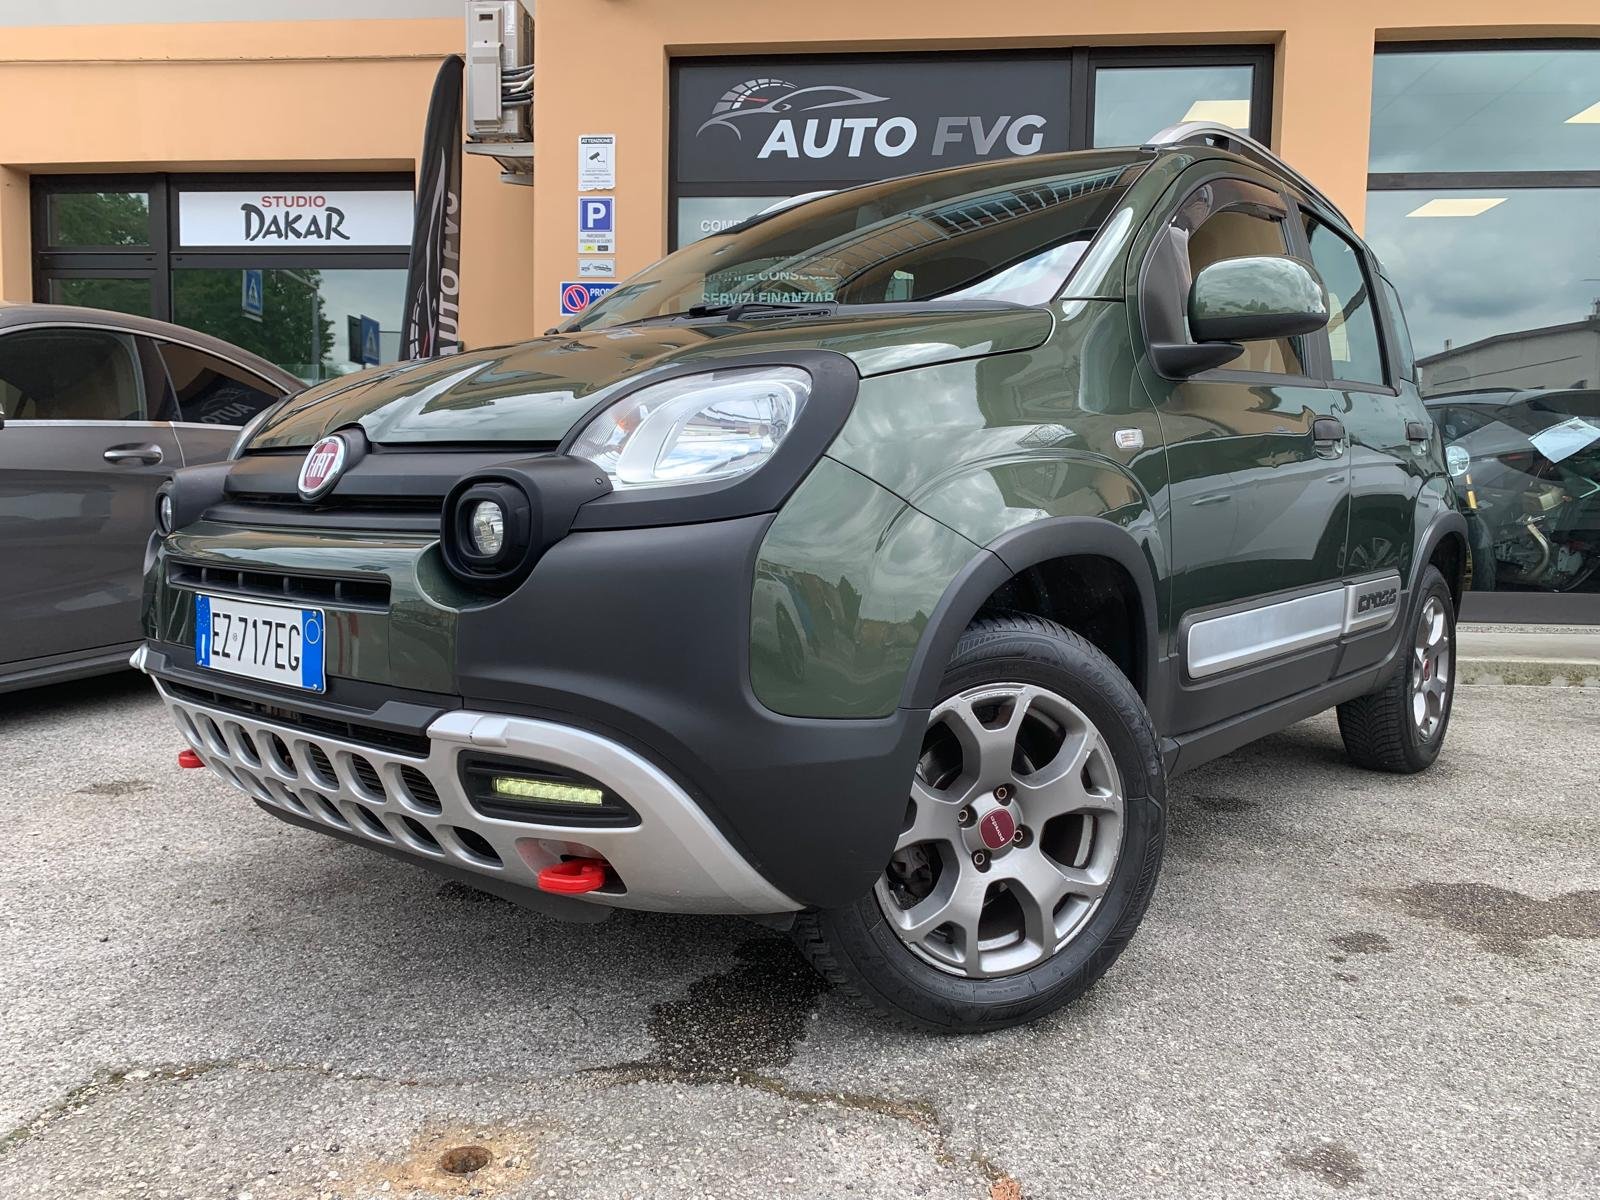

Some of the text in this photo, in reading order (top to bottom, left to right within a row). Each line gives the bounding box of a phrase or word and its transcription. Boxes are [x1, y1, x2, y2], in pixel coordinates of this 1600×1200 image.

[757, 114, 1047, 159] AUTO FVG
[261, 195, 326, 208] STUDIO
[241, 203, 351, 241] DAKAR
[587, 202, 606, 228] P
[305, 452, 336, 478] FIAT
